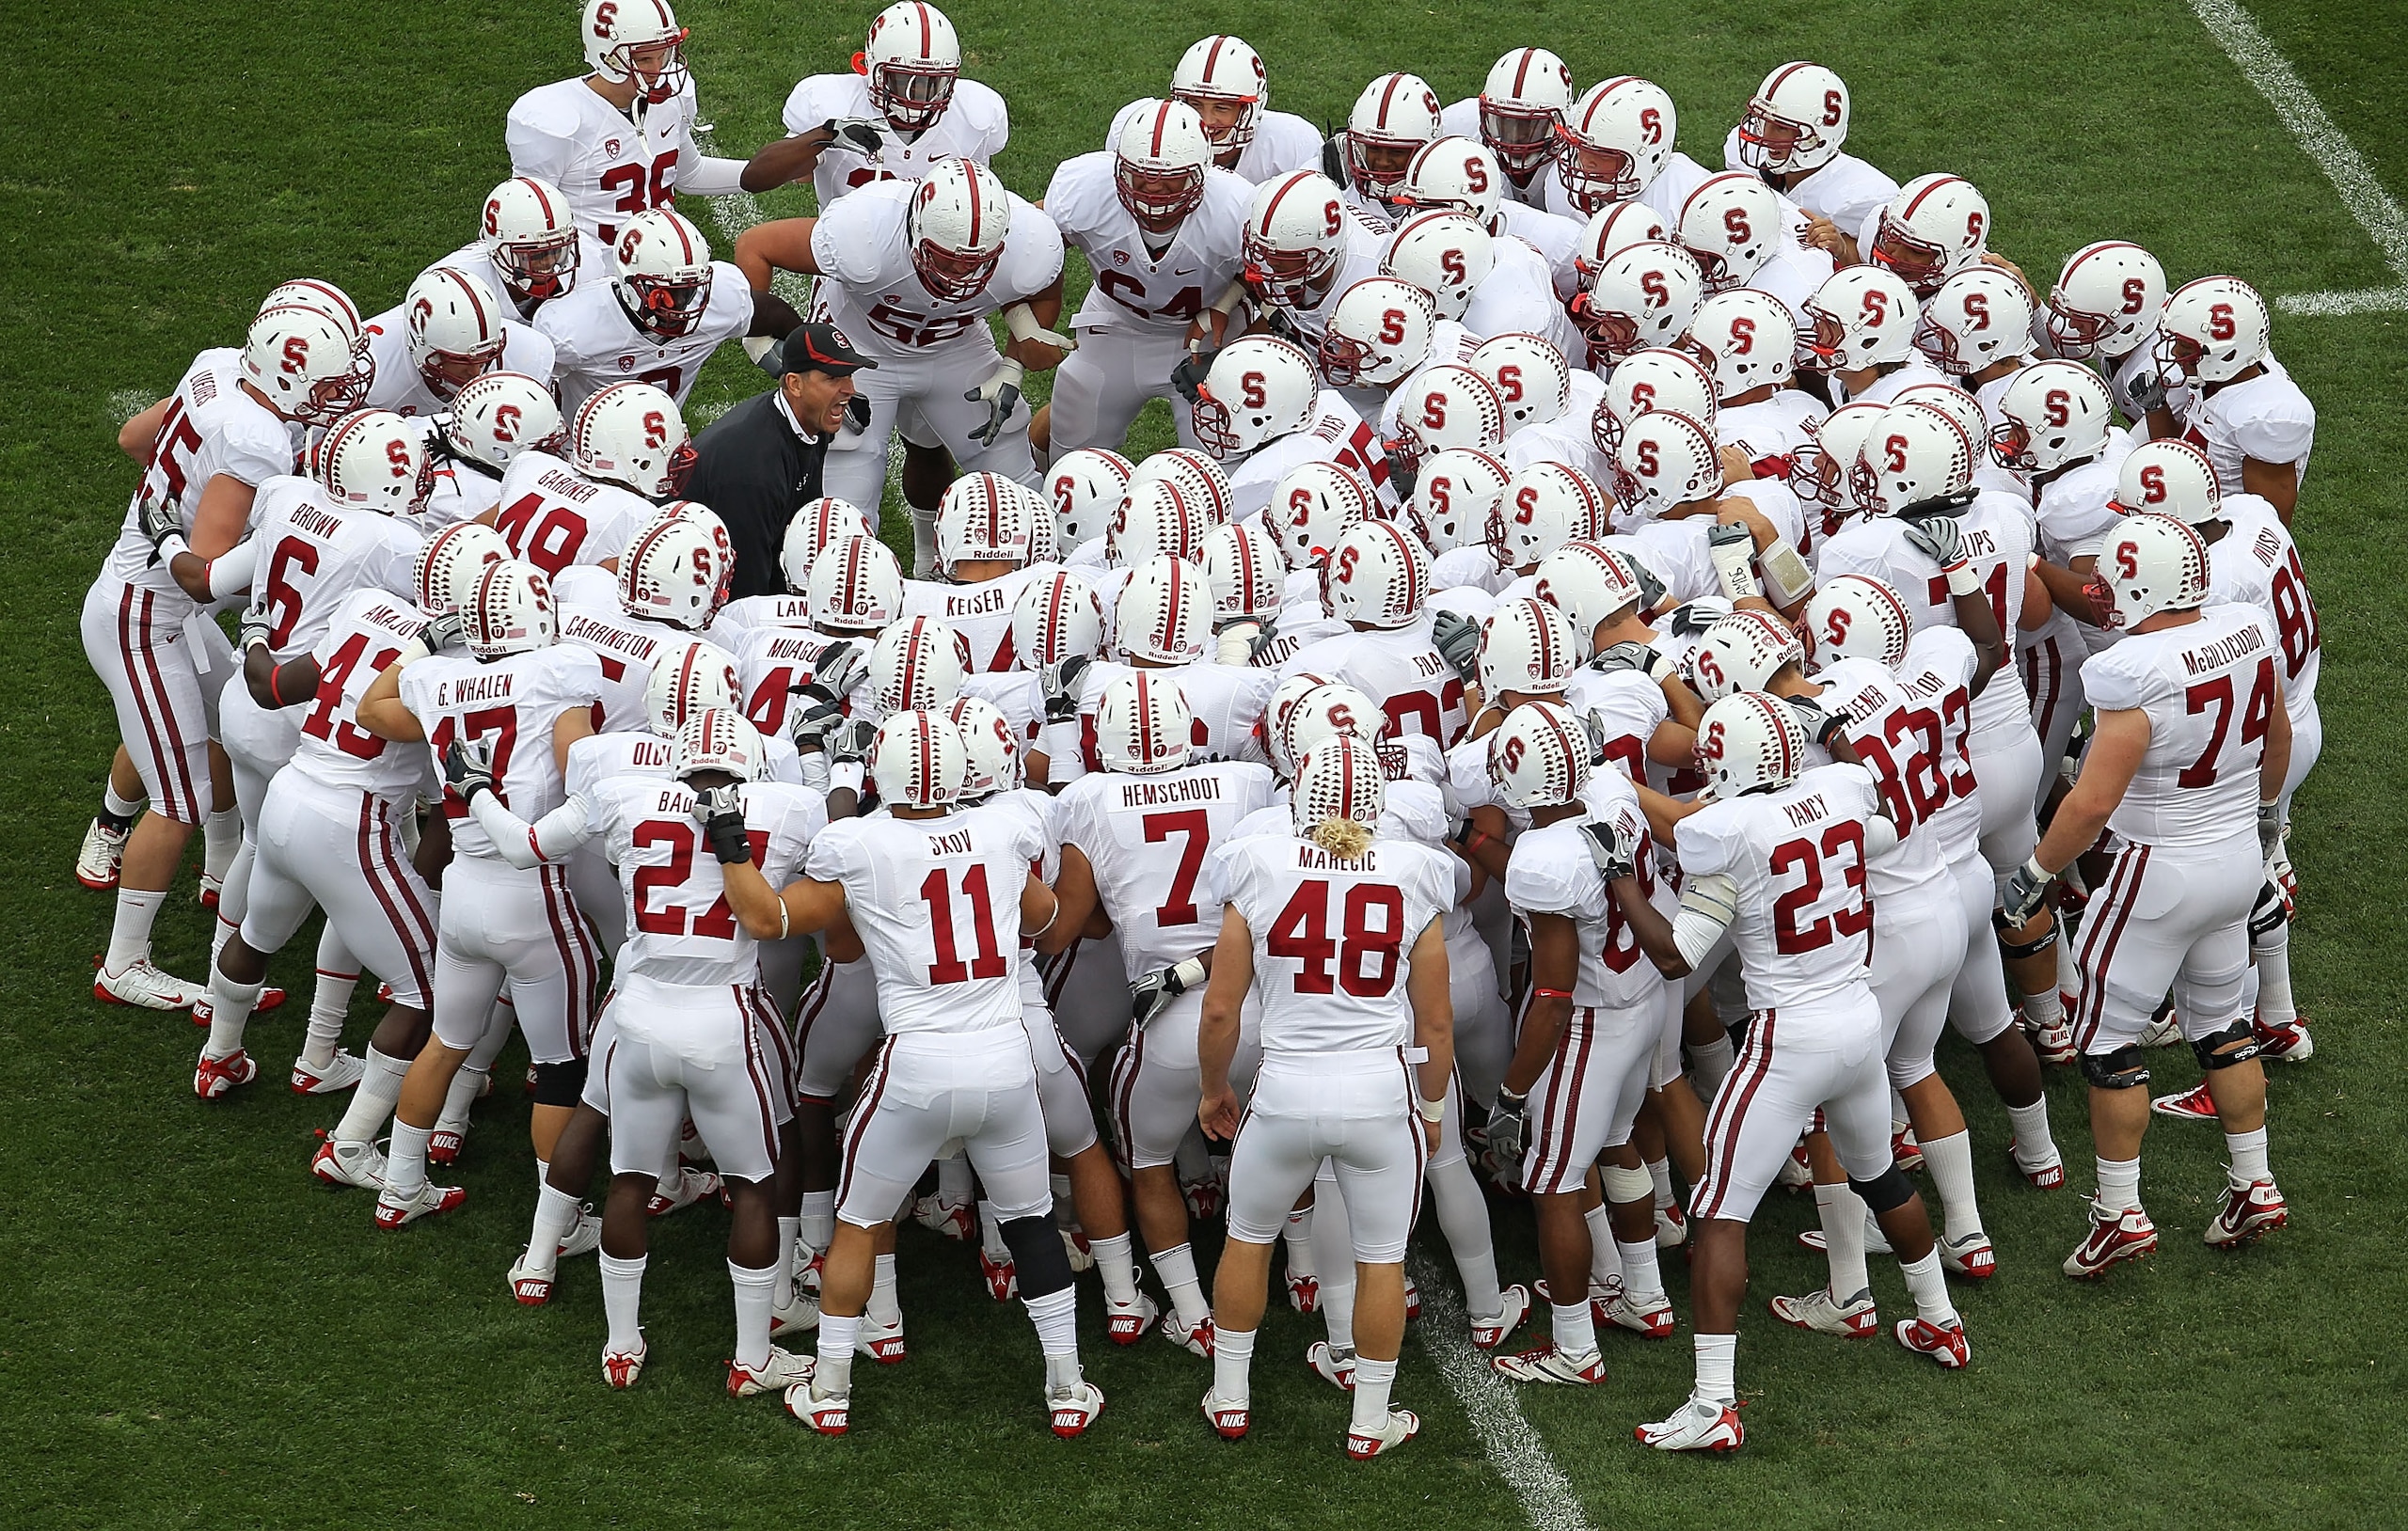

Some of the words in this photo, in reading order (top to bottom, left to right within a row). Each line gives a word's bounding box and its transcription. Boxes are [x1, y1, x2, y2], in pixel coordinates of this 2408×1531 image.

[594, 2, 619, 39] S
[1640, 107, 1663, 145] S
[1823, 89, 1843, 127] S
[1464, 156, 1489, 195] S
[484, 198, 501, 237] S
[1323, 199, 1342, 238] S
[1722, 207, 1751, 245] S
[1963, 210, 1984, 248] S
[619, 229, 643, 265] S
[1440, 247, 1466, 286] S
[1640, 270, 1671, 308] S
[1859, 288, 1888, 328] S
[2121, 277, 2145, 315] S
[1378, 308, 1408, 346] S
[1963, 292, 1991, 331] S
[2209, 303, 2237, 341] S
[280, 336, 309, 373] S
[1728, 316, 1756, 355] S
[1240, 371, 1267, 409] S
[1497, 364, 1524, 402] S
[493, 403, 522, 443] S
[1422, 391, 1448, 431] S
[2044, 388, 2071, 428] S
[642, 411, 667, 449] S
[385, 438, 412, 479] S
[1636, 439, 1660, 477] S
[1884, 433, 1909, 473] S
[538, 469, 599, 503] GARDNER
[1054, 475, 1075, 514] S
[1430, 475, 1451, 514] S
[2140, 465, 2168, 504] S
[290, 503, 341, 540] BROWN
[1287, 487, 1312, 527] S
[1514, 486, 1539, 526] S
[973, 549, 1014, 560] Riddell
[999, 530, 1011, 543] 94
[1960, 530, 1995, 559] LIPS
[692, 546, 712, 586] S
[1337, 545, 1360, 585] S
[2115, 541, 2139, 580] S
[266, 534, 320, 652] 6
[528, 575, 552, 611] S
[638, 590, 649, 601] 5
[855, 603, 868, 615] 47
[945, 589, 1005, 617] KEISER
[1256, 596, 1266, 608] 29
[490, 626, 503, 639] 17
[564, 615, 657, 661] CARRINGTON
[833, 617, 864, 626] Riddell
[1826, 607, 1853, 647] S
[470, 645, 508, 655] Riddell
[1148, 651, 1179, 661] Riddell
[1175, 642, 1186, 652] 56
[1413, 652, 1446, 677] FUA
[2181, 623, 2266, 676] McGILLICUDDY
[1531, 682, 1560, 691] Riddell
[1553, 665, 1563, 677] 80
[1698, 650, 1725, 688] S
[438, 683, 450, 707] G.
[455, 673, 515, 704] WHALEN
[992, 718, 1015, 755] S
[1326, 702, 1358, 737] S
[2178, 655, 2276, 790] 74
[713, 743, 726, 755] 27
[1503, 735, 1527, 775] S
[1706, 720, 1725, 761] S
[690, 757, 722, 766] Riddell
[934, 789, 945, 800] 11
[1122, 778, 1222, 808] HEMSCHOOT
[1782, 794, 1830, 829] YANCY
[1354, 810, 1365, 821] 48
[927, 829, 974, 857] SKOV
[1298, 845, 1377, 872] MARECIC
[632, 819, 770, 941] 27
[1142, 809, 1211, 928] 7
[1768, 819, 1870, 956] 23
[920, 863, 1007, 986] 11
[1267, 879, 1405, 998] 48
[432, 1134, 460, 1149] NIKE
[2036, 1168, 2061, 1186] NIKE
[1972, 1250, 1995, 1268] NIK
[518, 1283, 548, 1298] NIKE
[1111, 1319, 1137, 1334] NIKE
[1656, 1311, 1674, 1327] NIK
[1859, 1311, 1877, 1329] NIK
[1344, 1372, 1355, 1384] NI
[820, 1413, 848, 1428] NIKE
[1054, 1413, 1081, 1427] NIKE
[1219, 1413, 1246, 1428] NIKE
